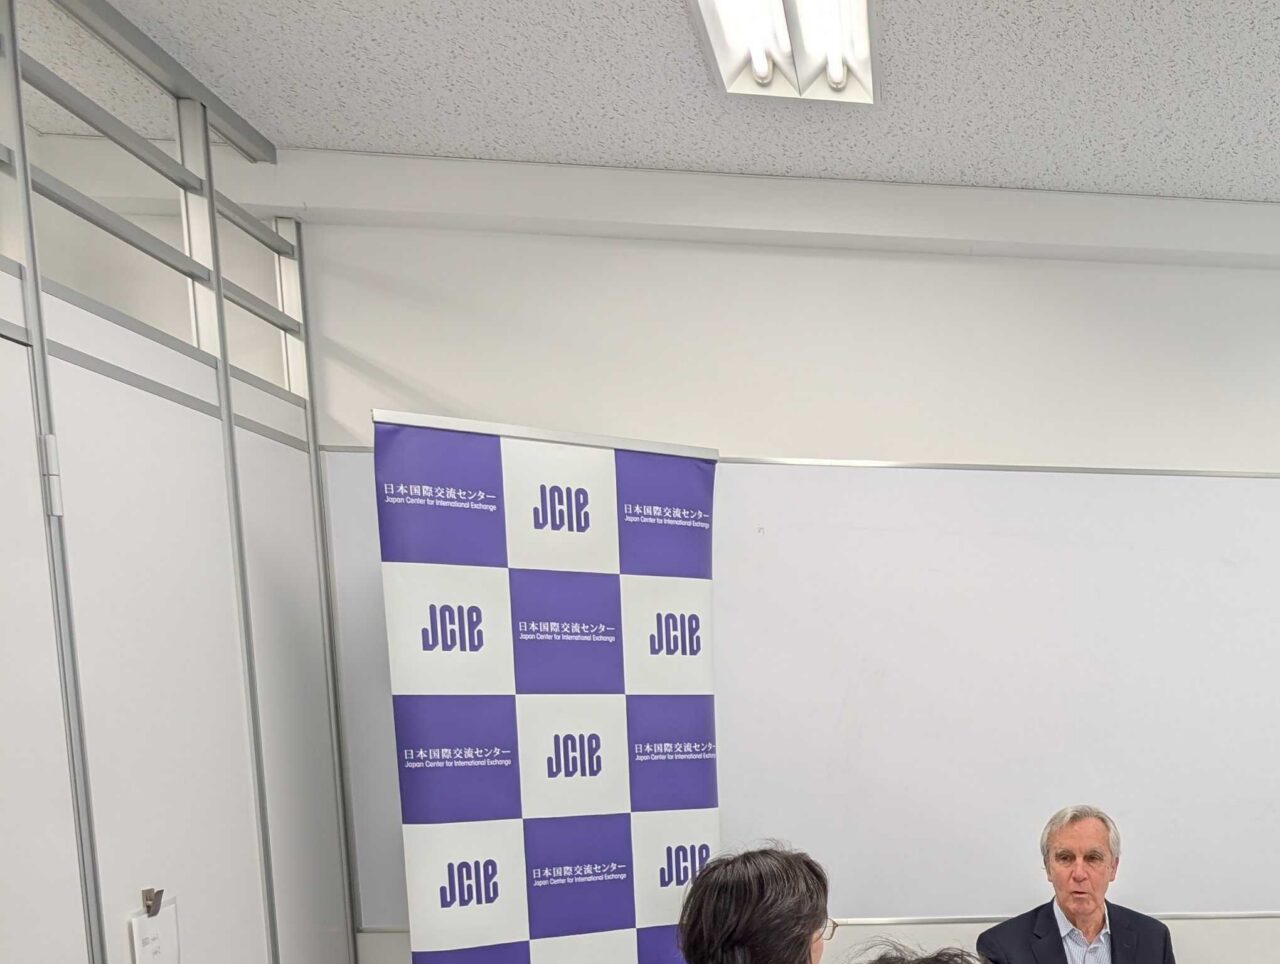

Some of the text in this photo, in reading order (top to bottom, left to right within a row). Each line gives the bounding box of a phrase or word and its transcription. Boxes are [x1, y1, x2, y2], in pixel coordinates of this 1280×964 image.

[384, 483, 496, 500] 日本国際交流センター
[624, 504, 709, 519] 日本国際交流センター
[519, 621, 615, 633] 日本国際交流センター
[404, 747, 511, 759] 日本国際交流センター
[533, 862, 626, 878] 日本国際交流センター
